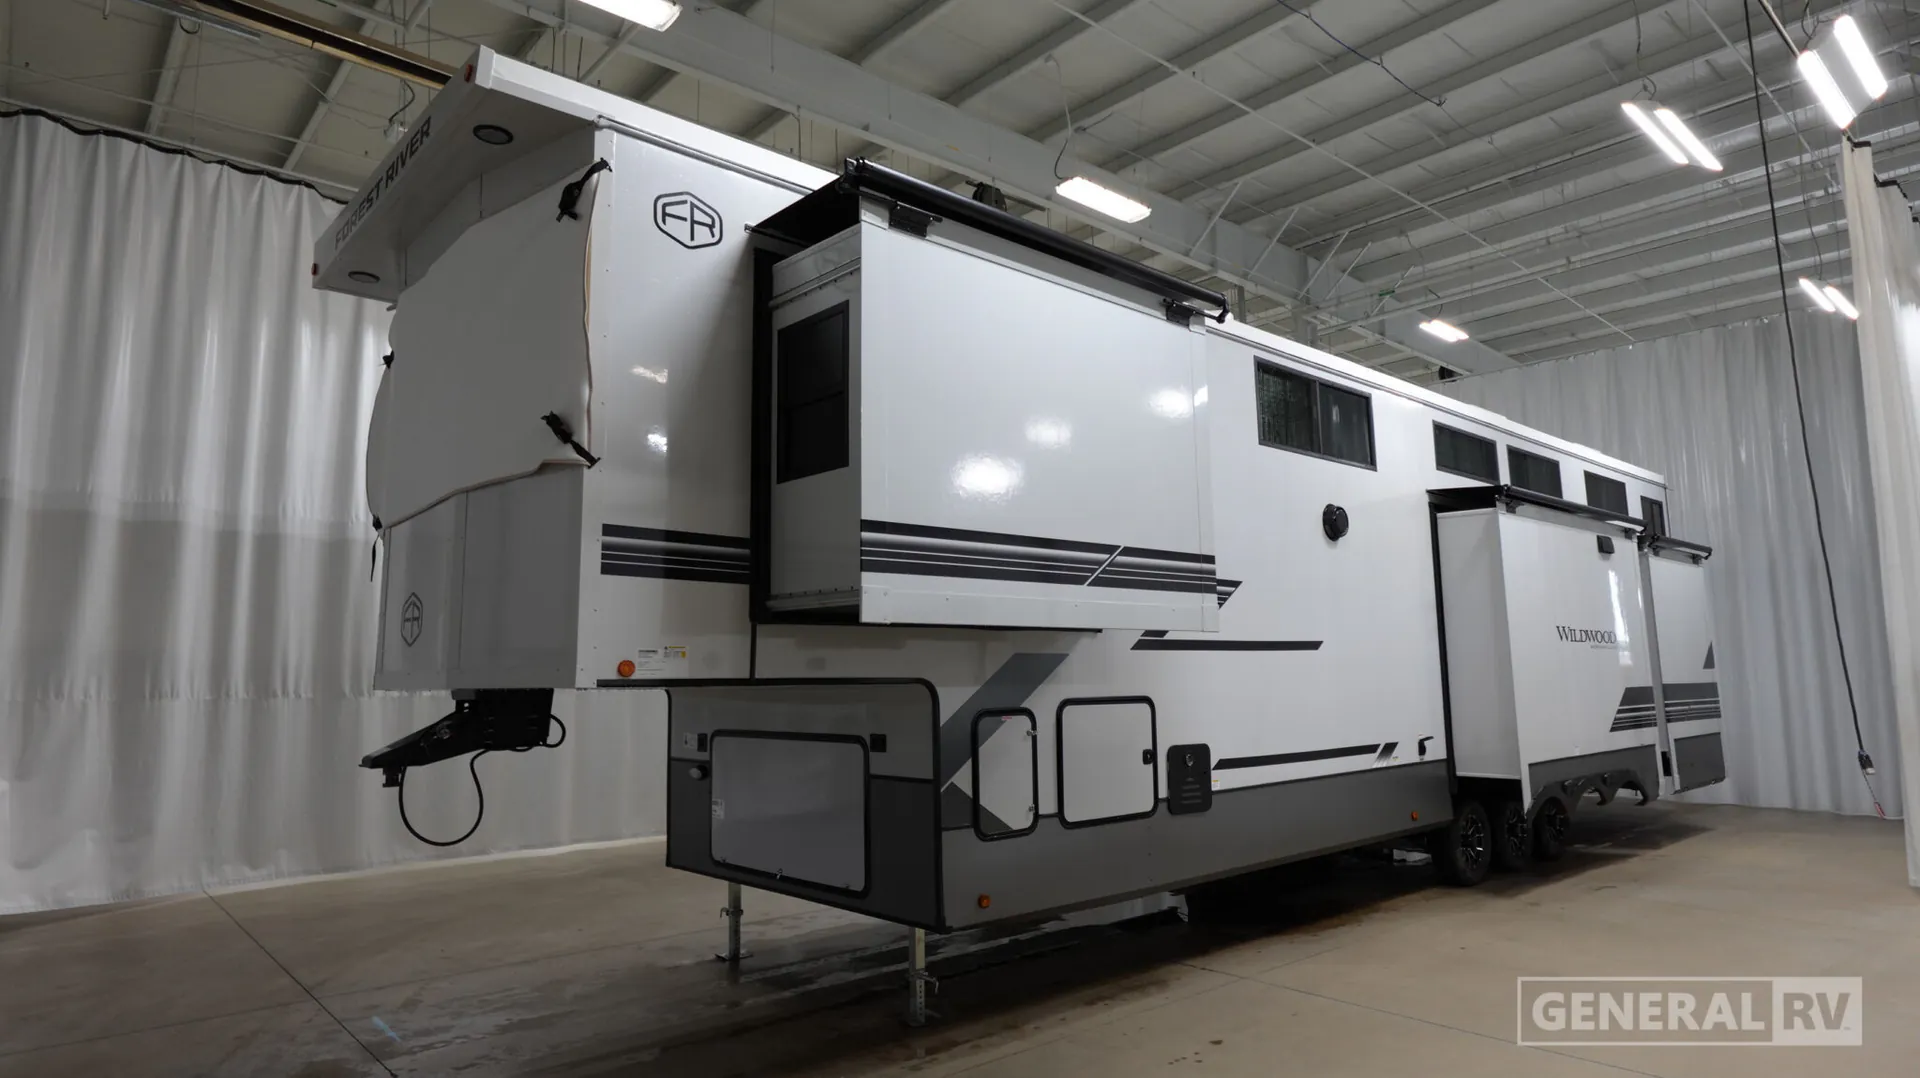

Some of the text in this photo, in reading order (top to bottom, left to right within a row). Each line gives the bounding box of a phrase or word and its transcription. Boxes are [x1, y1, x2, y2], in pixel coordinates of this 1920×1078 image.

[334, 116, 432, 250] FOREST RIVER
[661, 199, 716, 242] FR
